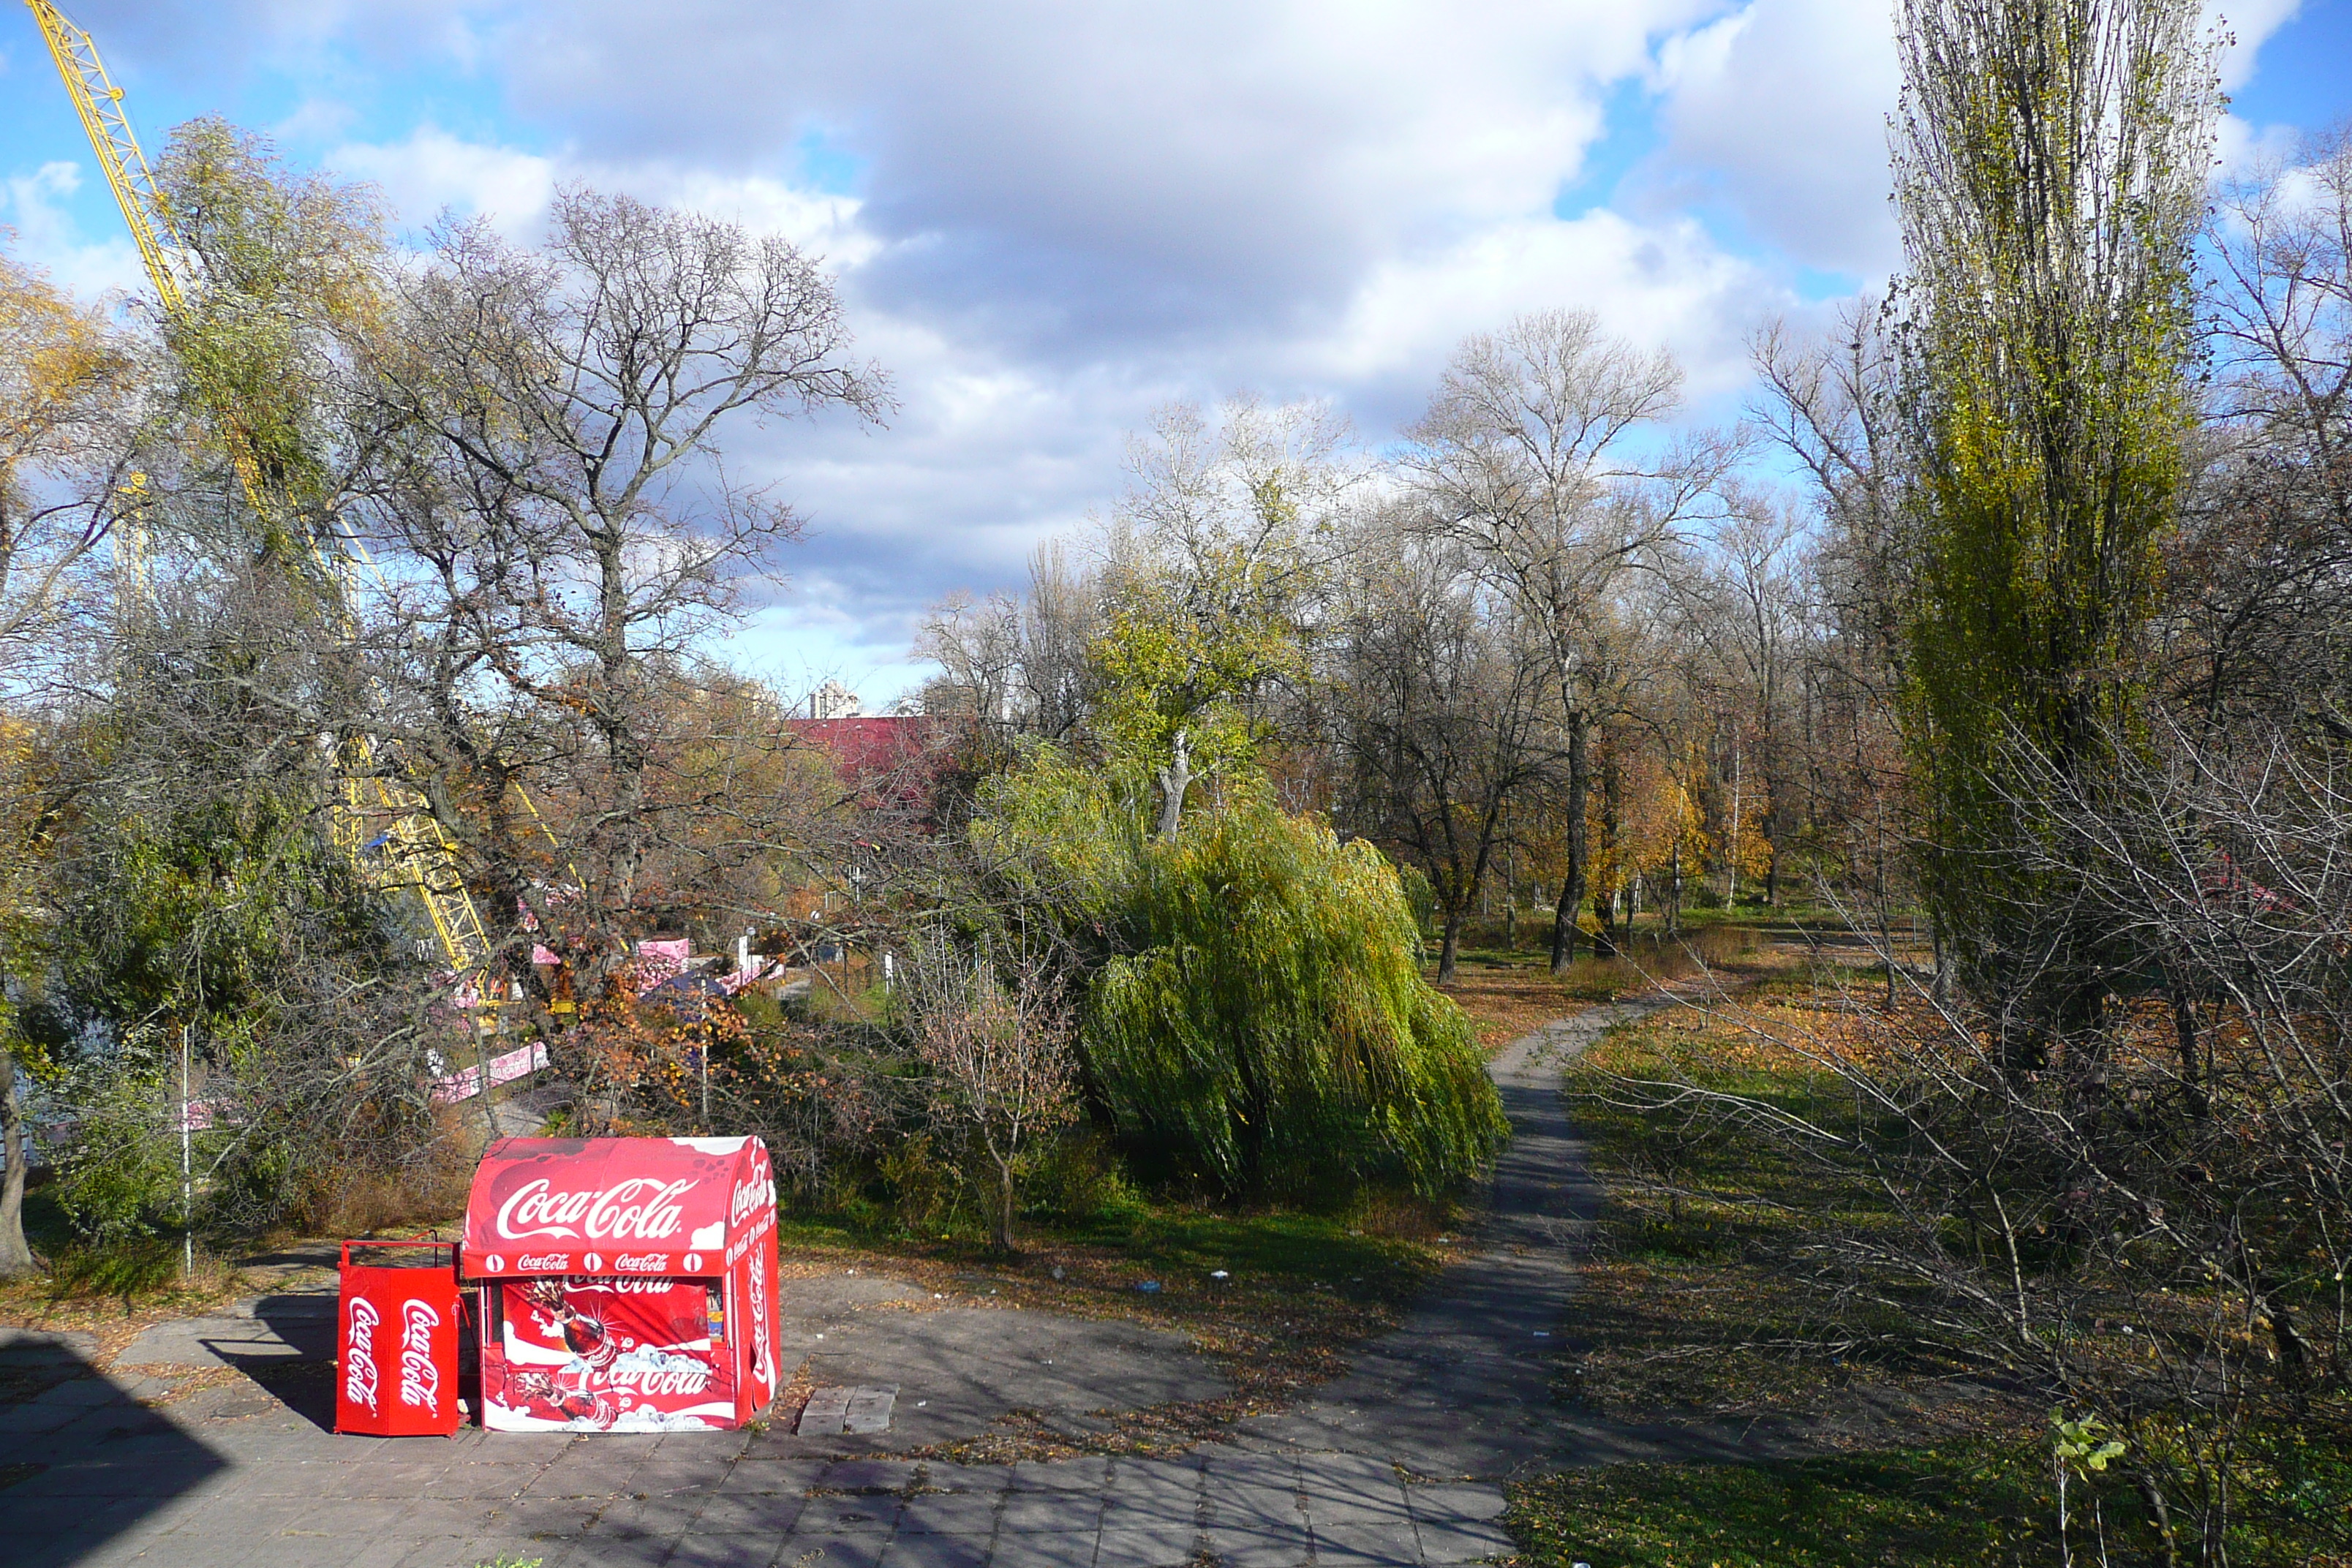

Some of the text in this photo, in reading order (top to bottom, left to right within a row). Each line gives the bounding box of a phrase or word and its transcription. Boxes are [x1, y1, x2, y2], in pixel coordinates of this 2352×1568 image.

[497, 1178, 700, 1240] Coca-Cola
[517, 1253, 570, 1271] Coca-Cola
[614, 1253, 669, 1272] Coca-Cola
[562, 1275, 674, 1294] CocaCola
[347, 1297, 379, 1411] Coca-Cola
[402, 1298, 439, 1413] Coca-Cola
[578, 1372, 707, 1395] CocaCola
